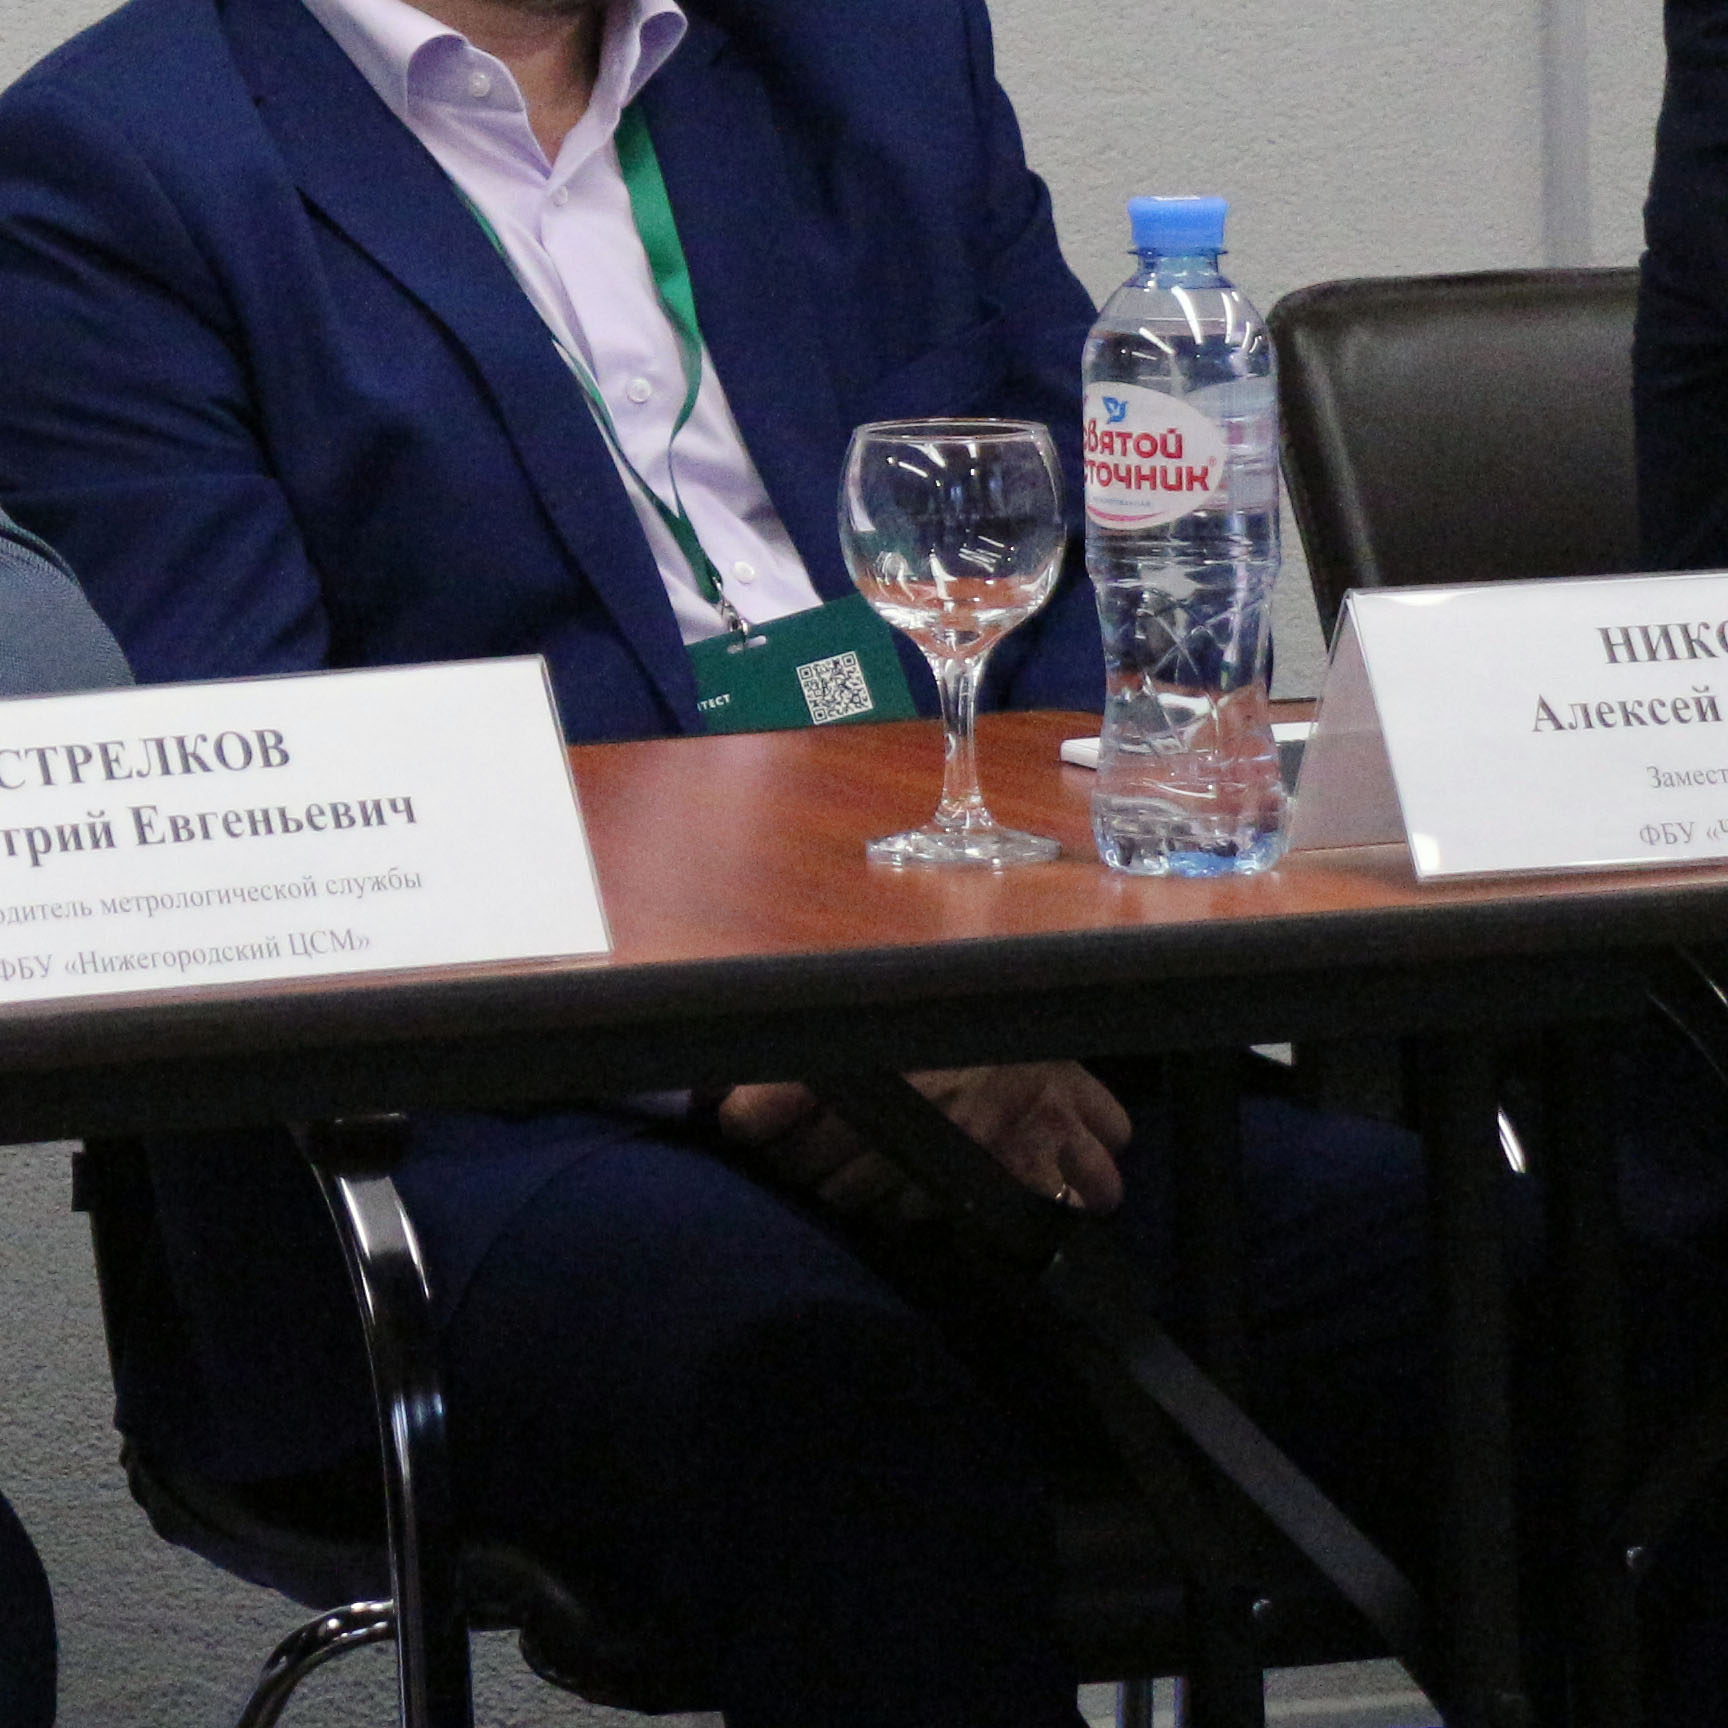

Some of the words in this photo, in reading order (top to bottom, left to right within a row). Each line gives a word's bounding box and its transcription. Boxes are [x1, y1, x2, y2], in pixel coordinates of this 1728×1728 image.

[1531, 684, 1724, 733] Алексей
[127, 795, 418, 847] Евгеньевич
[1638, 821, 1695, 847] ФБУ
[101, 876, 317, 917] метрологической
[326, 867, 422, 899] службы
[64, 940, 287, 978] «Нижегородский
[289, 929, 369, 958] ЦСМ»
